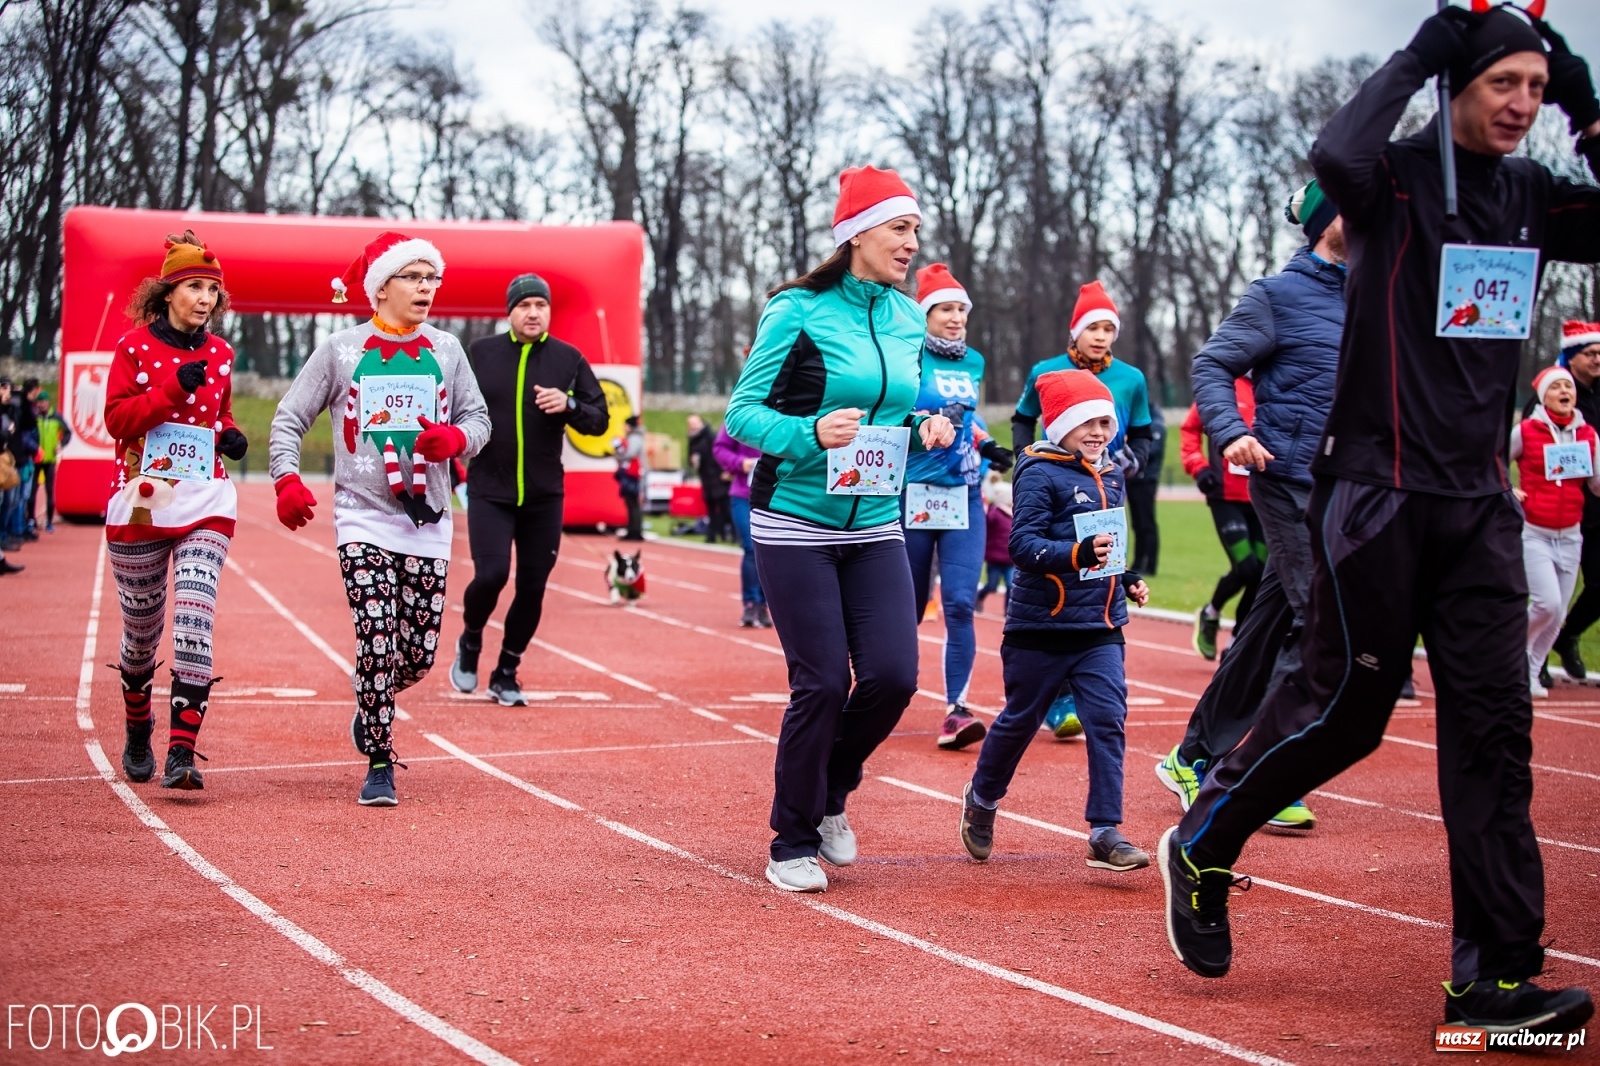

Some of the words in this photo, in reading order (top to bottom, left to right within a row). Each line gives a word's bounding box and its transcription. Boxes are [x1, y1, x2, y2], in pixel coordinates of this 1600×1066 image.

[1474, 278, 1510, 301] 047
[385, 394, 414, 408] 057
[168, 442, 196, 459] 053
[855, 449, 885, 468] 003
[925, 499, 949, 511] 064
